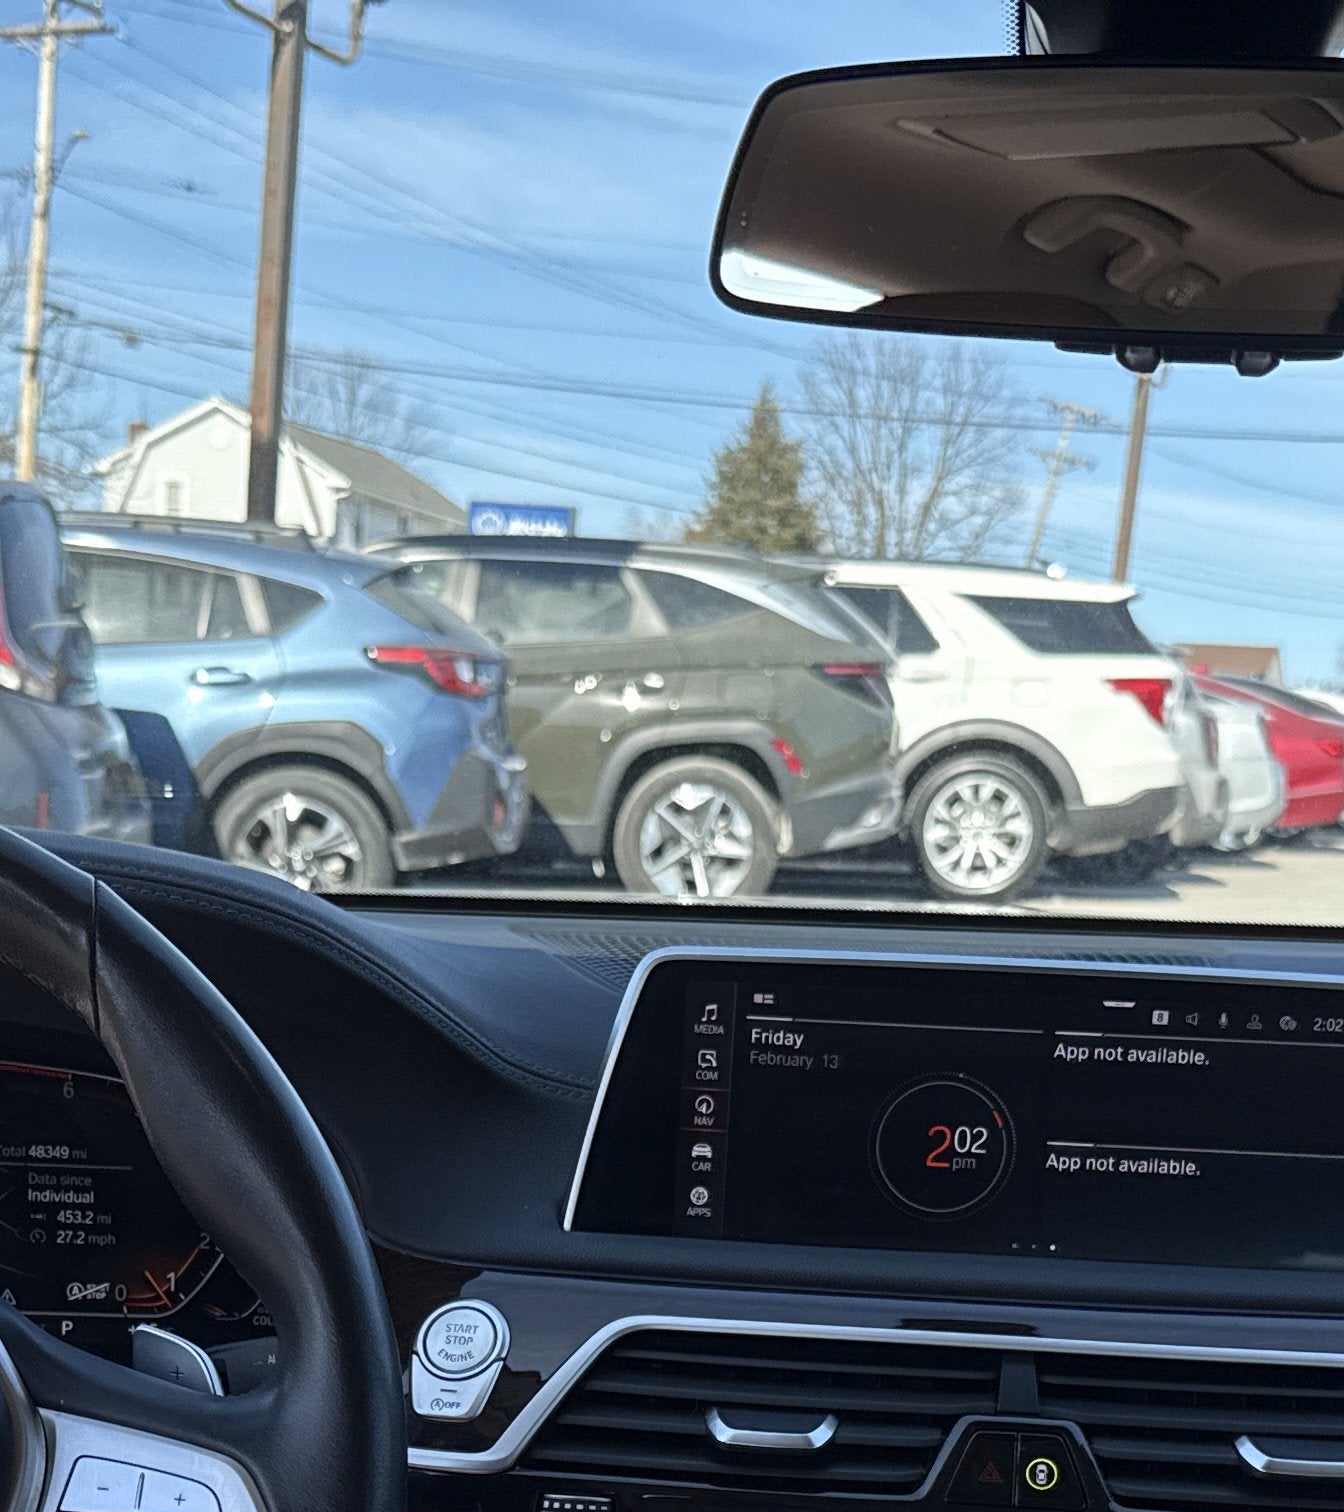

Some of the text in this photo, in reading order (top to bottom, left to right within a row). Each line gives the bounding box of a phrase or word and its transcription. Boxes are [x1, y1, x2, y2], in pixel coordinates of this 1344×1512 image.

[694, 1024, 724, 1036] MEDIA
[751, 1027, 805, 1050] Friday
[749, 1050, 840, 1070] February 13
[1054, 1042, 1210, 1066] App not available.
[695, 1070, 719, 1081] COM
[62, 1081, 75, 1099] 6
[693, 1115, 715, 1127] NAV
[28, 1145, 70, 1160] 48349
[72, 1149, 88, 1160] mi
[691, 1161, 712, 1172] CAR
[951, 1157, 977, 1171] pm
[1045, 1153, 1201, 1177] App not available.
[28, 1172, 92, 1186] Data since
[27, 1188, 95, 1204] Individual
[56, 1210, 94, 1225] 453.2
[686, 1206, 713, 1218] APPS
[56, 1230, 116, 1247] 27.2 mph
[166, 1271, 175, 1292] 1
[115, 1283, 127, 1302] 0
[61, 1320, 74, 1336] P
[444, 1323, 479, 1335] START
[444, 1334, 474, 1346] STOP
[437, 1348, 475, 1363] ENGINE
[444, 1401, 462, 1410] OFF
